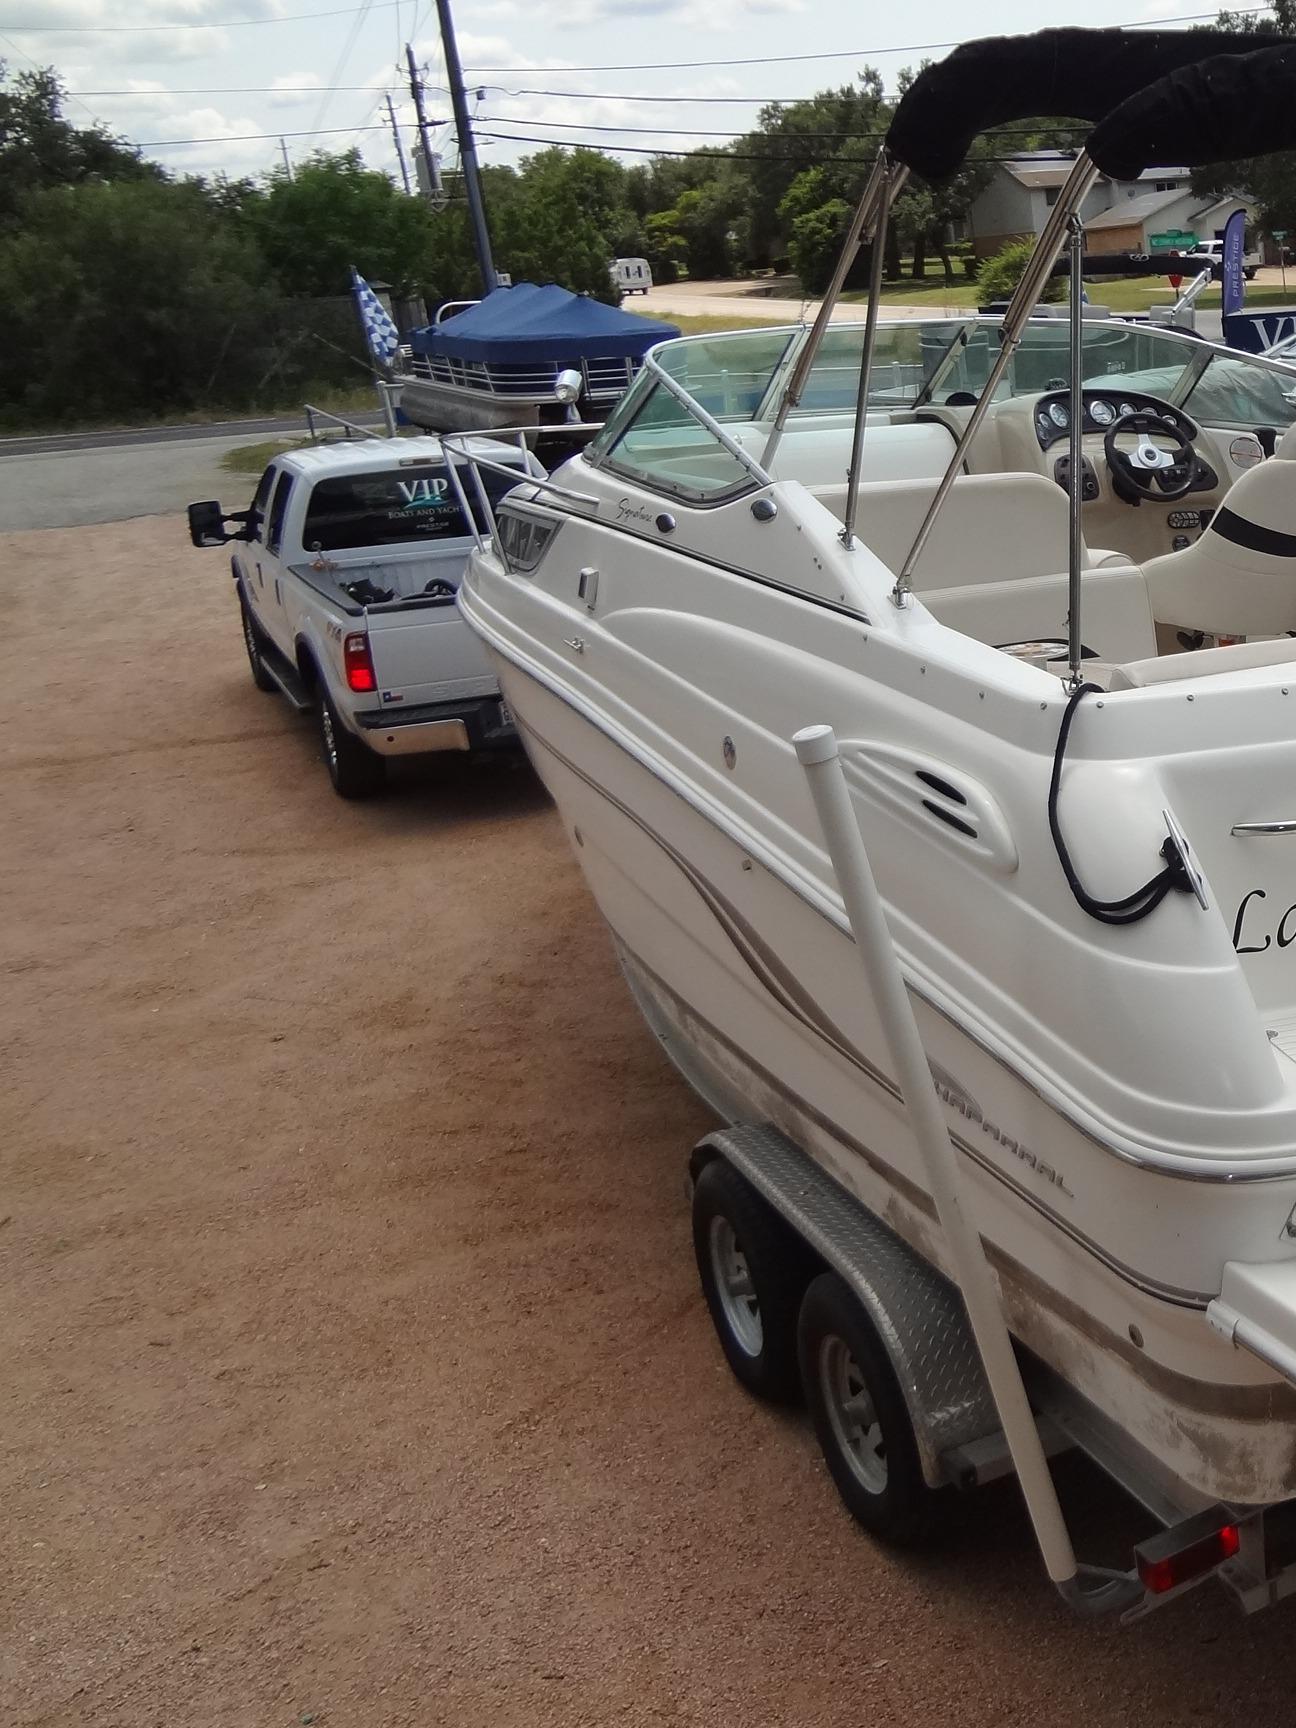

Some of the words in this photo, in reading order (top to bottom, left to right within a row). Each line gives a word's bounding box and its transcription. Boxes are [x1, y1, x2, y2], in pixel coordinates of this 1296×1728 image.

[1231, 233, 1240, 297] PRESTIGE
[397, 478, 448, 502] VIP
[388, 510, 414, 519] BOATS
[416, 507, 435, 515] AND
